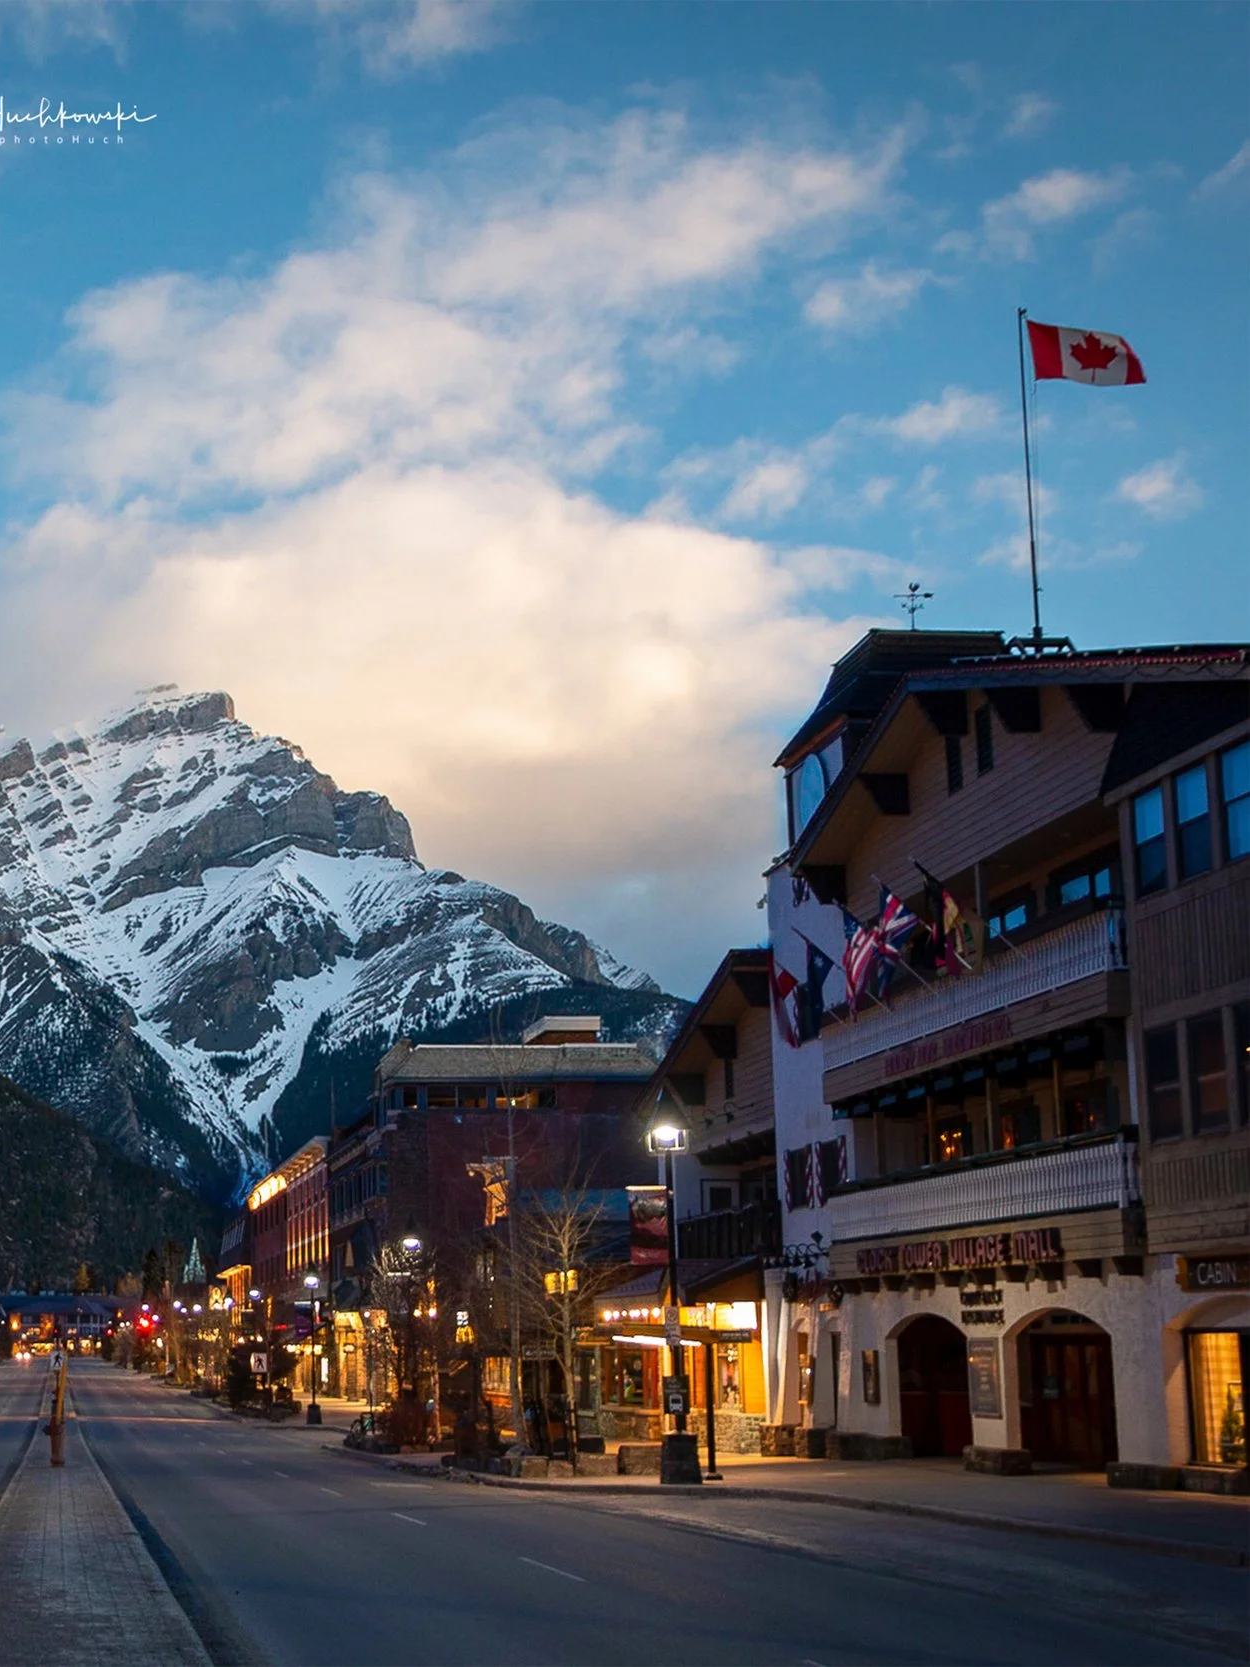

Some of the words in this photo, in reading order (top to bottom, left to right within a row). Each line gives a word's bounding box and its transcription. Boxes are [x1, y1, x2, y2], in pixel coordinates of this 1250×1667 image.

[901, 1241, 944, 1270] TOWER
[949, 1234, 1004, 1265] VILLAGE
[1011, 1230, 1058, 1260] MALL
[1196, 1261, 1238, 1286] CABIN
